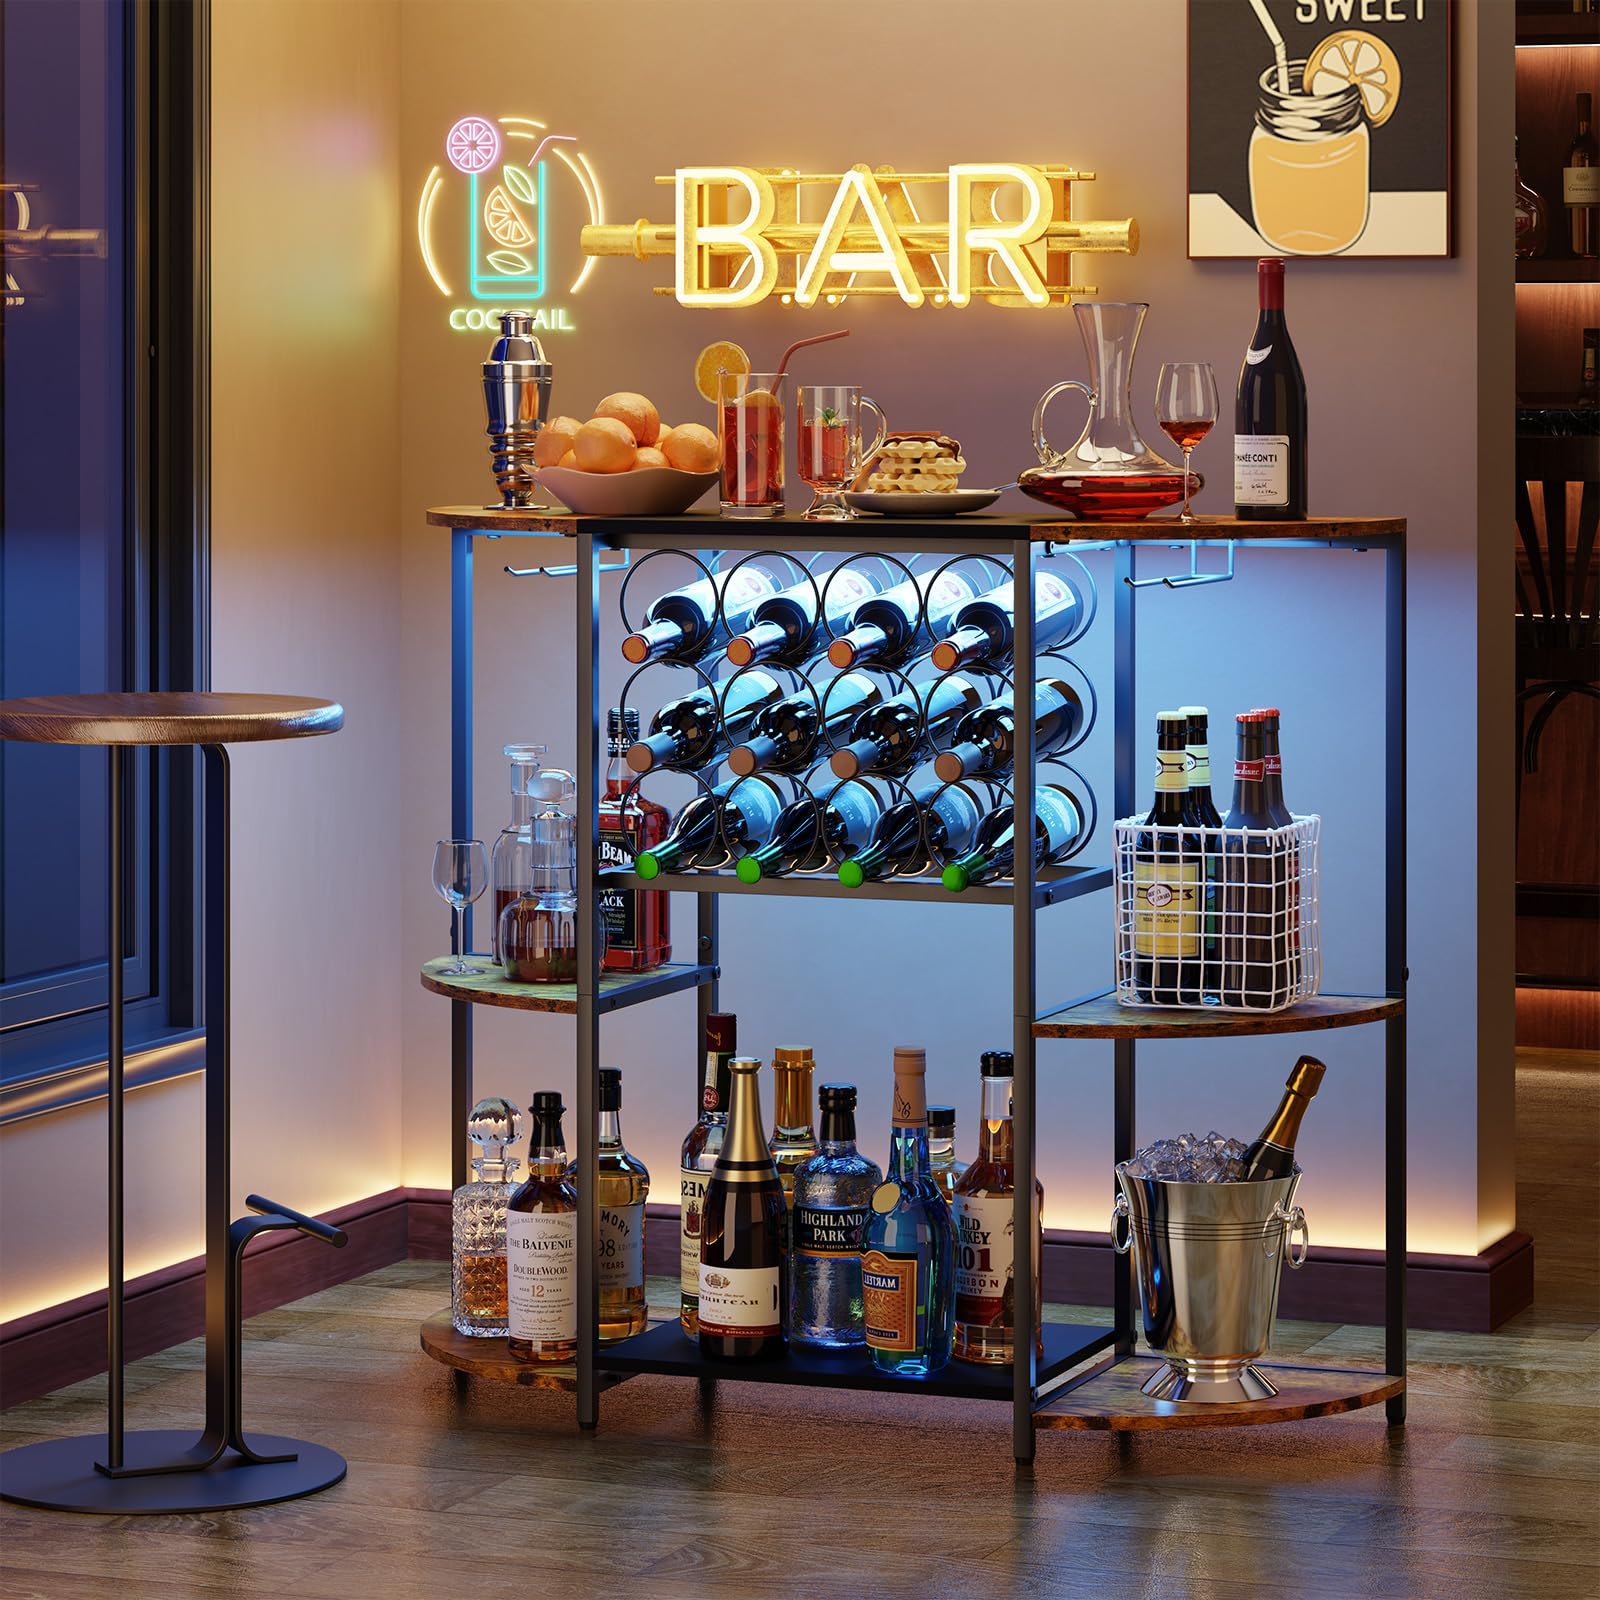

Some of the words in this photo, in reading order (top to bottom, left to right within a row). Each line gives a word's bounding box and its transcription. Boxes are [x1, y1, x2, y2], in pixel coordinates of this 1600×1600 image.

[675, 163, 1054, 308] BAR
[449, 308, 577, 331] COCAIL
[602, 841, 633, 866] BEAM
[600, 896, 625, 908] ACK
[601, 1210, 631, 1237] MORY
[800, 1209, 864, 1227] HIGHLAND
[959, 1214, 981, 1232] WILD
[814, 1228, 847, 1242] PARK
[957, 1230, 991, 1246] URKEY
[509, 1238, 521, 1248] THE
[522, 1238, 575, 1251] BALVENIE
[600, 1260, 625, 1270] YEARS
[956, 1274, 999, 1288] OURBON
[531, 1284, 545, 1297] 12
